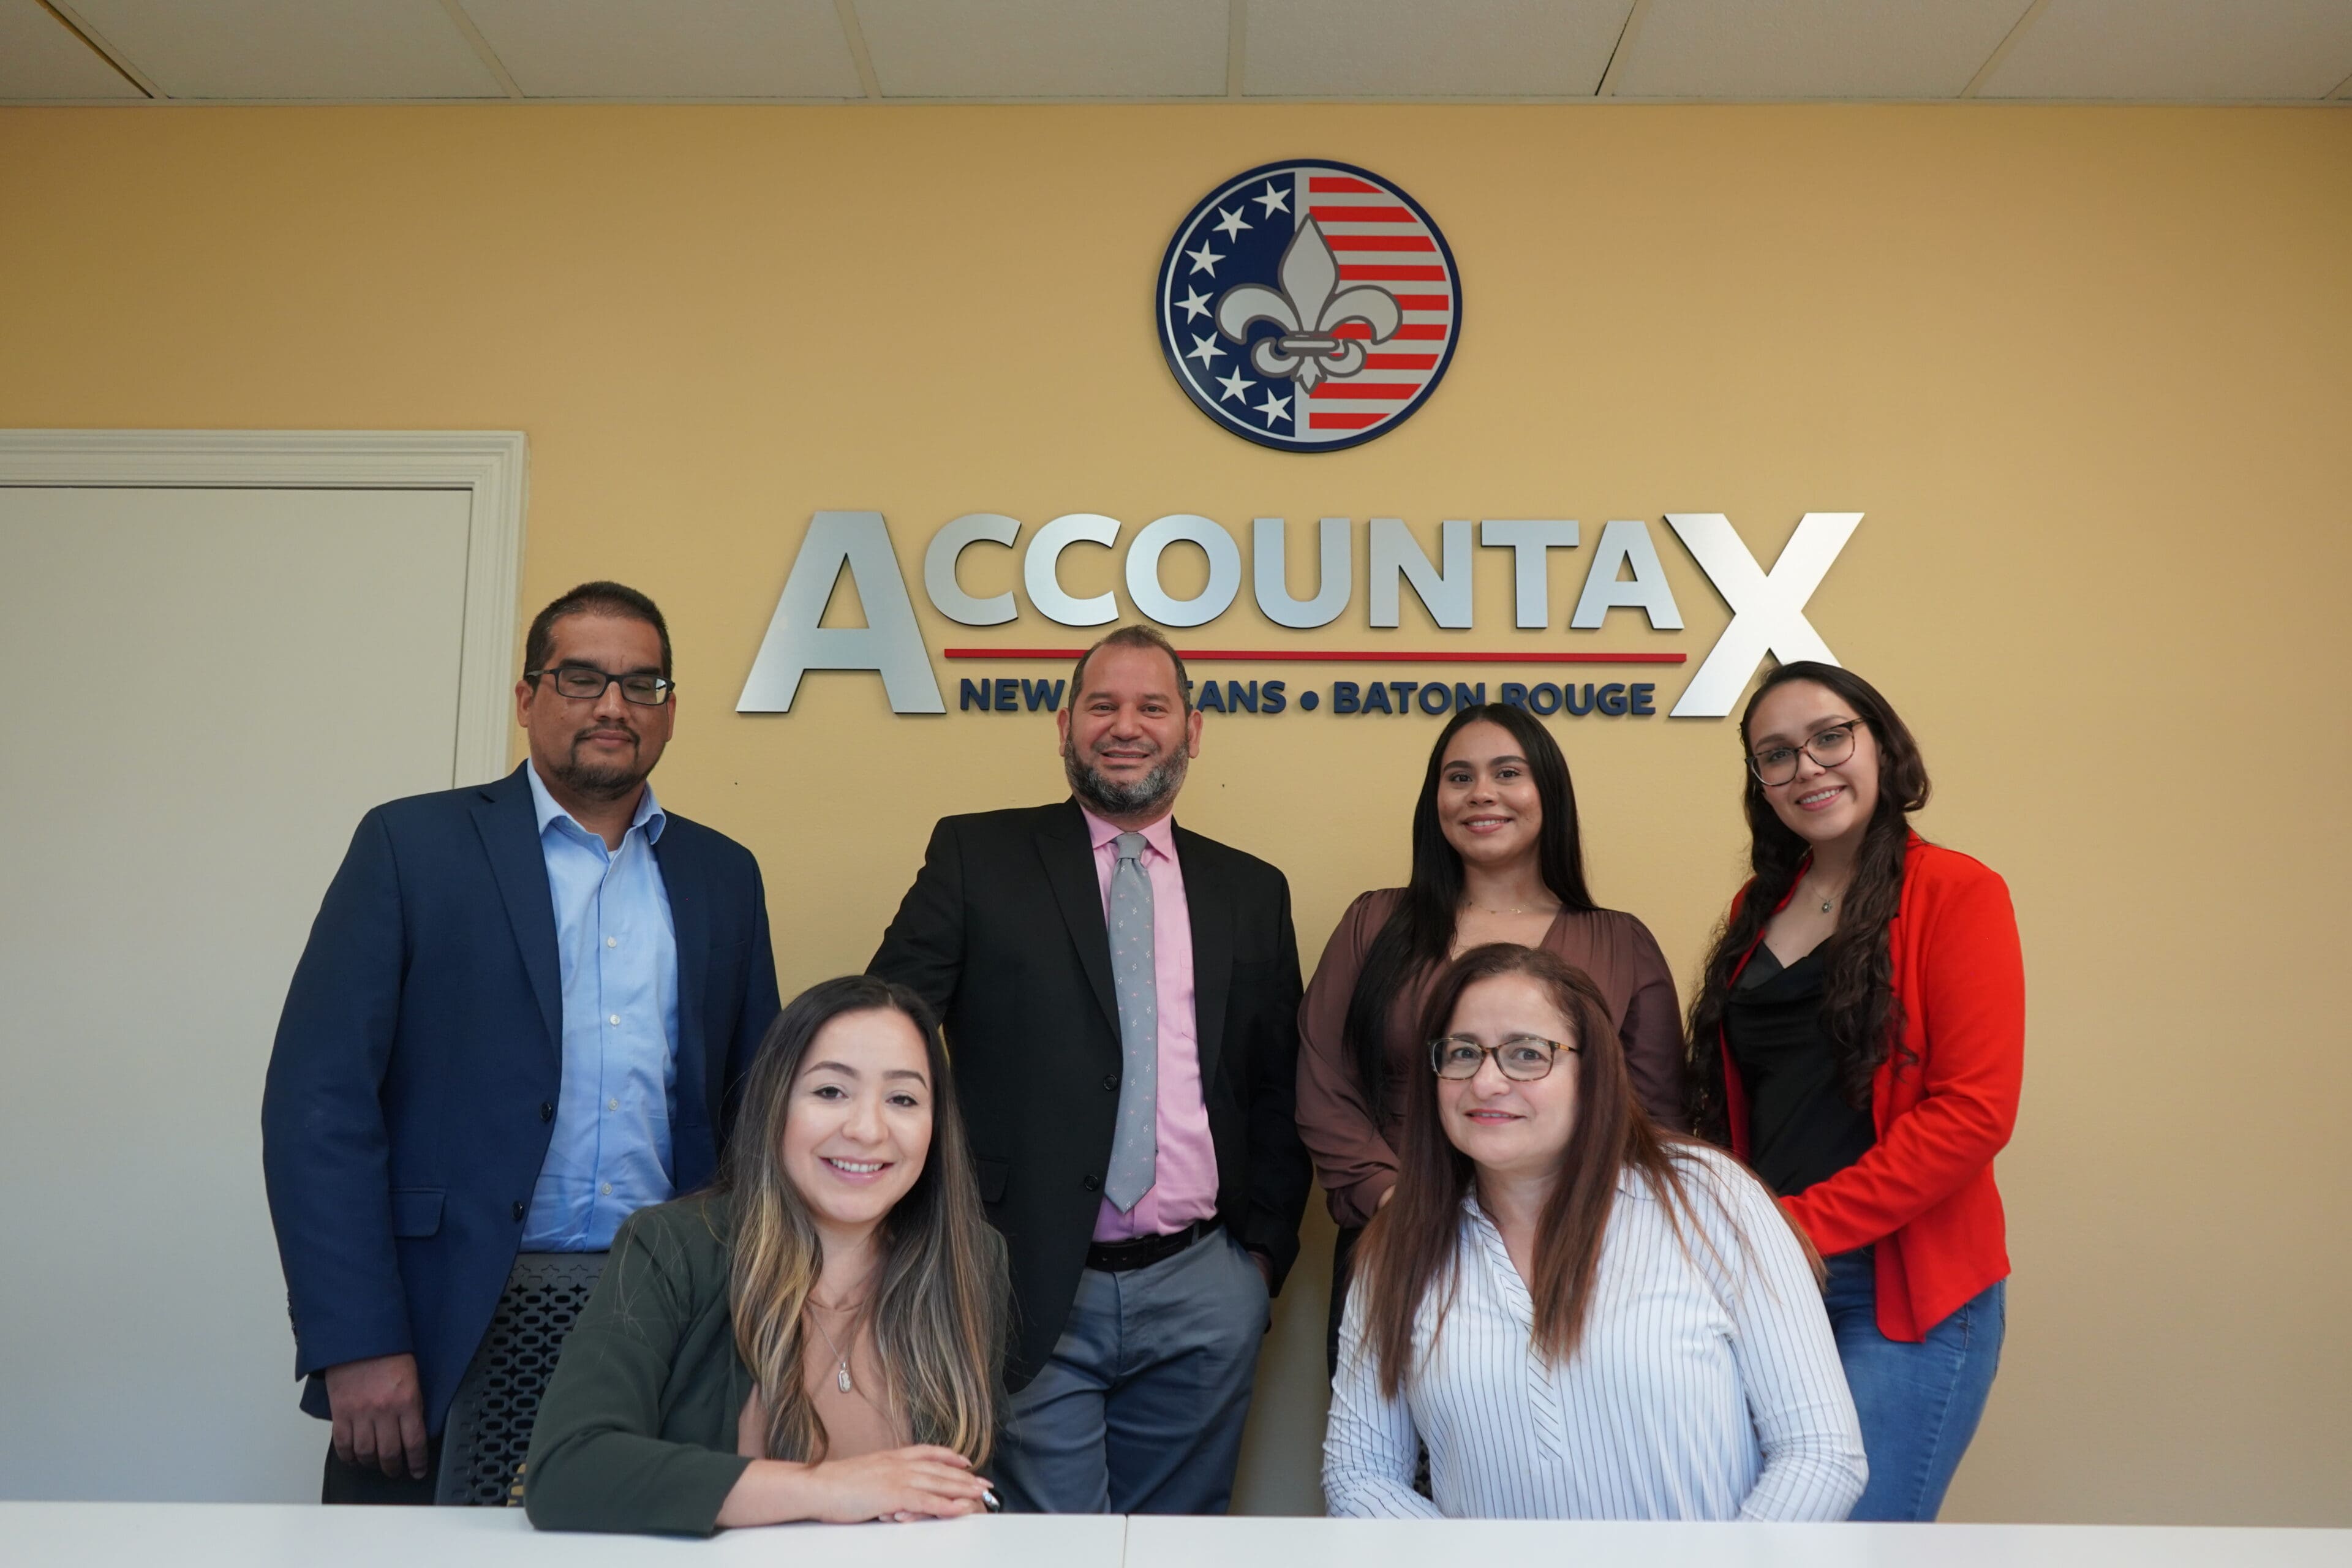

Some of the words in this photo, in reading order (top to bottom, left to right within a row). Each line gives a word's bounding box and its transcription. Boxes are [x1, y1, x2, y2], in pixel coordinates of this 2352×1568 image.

[736, 511, 1865, 717] ACCOUNTAX
[960, 678, 1065, 712] NEW
[1333, 681, 1485, 715] BATON
[1501, 682, 1656, 716] ROUGE
